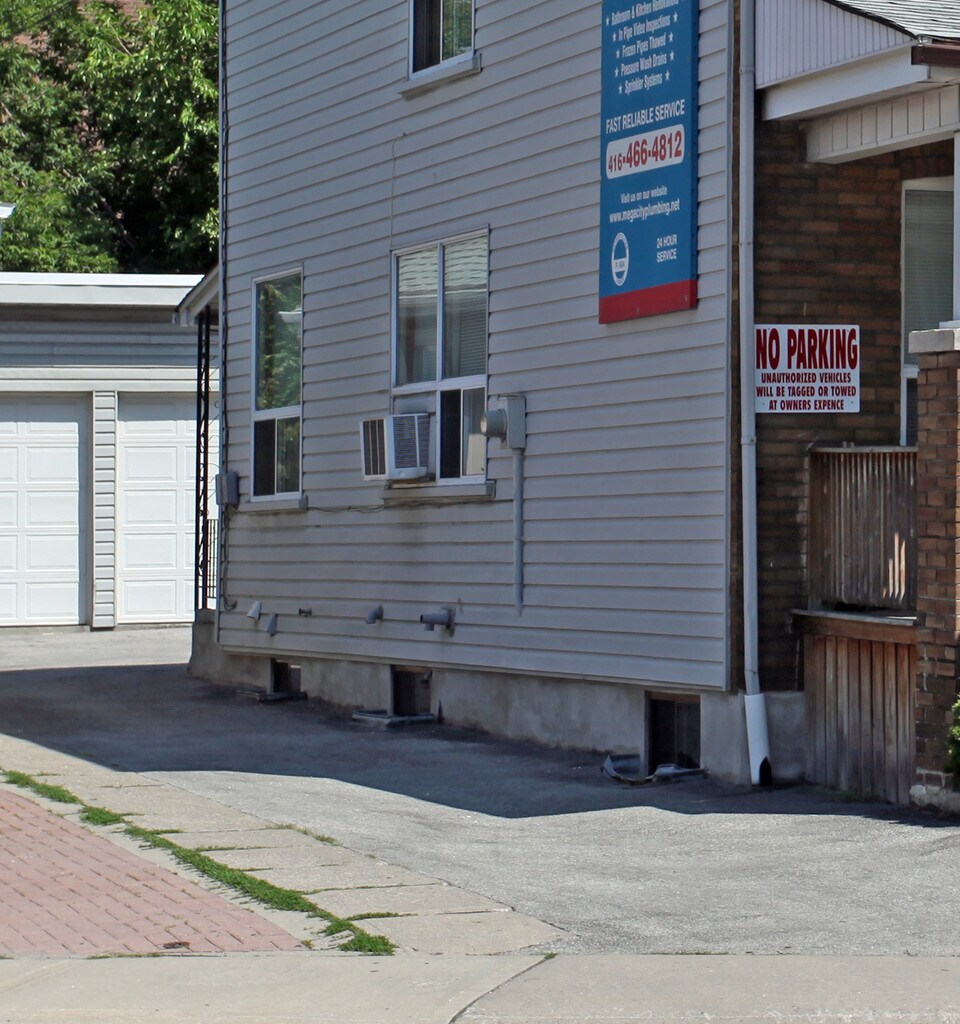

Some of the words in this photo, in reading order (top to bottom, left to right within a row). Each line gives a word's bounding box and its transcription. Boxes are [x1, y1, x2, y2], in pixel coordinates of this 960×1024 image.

[636, 2, 651, 17] Kitchen
[624, 26, 632, 41] Pipe
[633, 22, 645, 36] Video
[646, 15, 670, 33] Inspections
[622, 44, 636, 57] Frozen
[637, 40, 648, 55] Pipes
[649, 32, 666, 49] Thawed
[621, 62, 639, 76] Pressure
[640, 55, 652, 70] Wash
[653, 52, 667, 67] Drains
[625, 77, 643, 95] Sprinkler
[644, 73, 662, 90] Systems
[606, 115, 621, 134] FAST
[622, 108, 653, 130] RELIABLE
[655, 99, 685, 121] SERVICE
[608, 130, 682, 172] 416-466-4812
[621, 192, 630, 204] Visit
[631, 193, 635, 202] us
[636, 192, 642, 200] on
[651, 185, 667, 197] website
[609, 198, 680, 223] www.megacityplumbing.net
[657, 238, 662, 249] 24
[663, 234, 677, 247] HOUR
[657, 248, 677, 263] SERVICE
[756, 328, 780, 370] NO
[787, 328, 858, 370] PARKING
[761, 372, 817, 384] UNAUTHORIZED
[819, 372, 851, 384] VEHICLES
[756, 386, 773, 397] WILL
[776, 386, 785, 397] BE
[788, 386, 815, 397] TAGGED
[818, 386, 829, 397] OR
[831, 386, 856, 397] TOWED
[769, 400, 777, 411] AT
[780, 400, 811, 411] OWNERS
[814, 400, 844, 411] EXPENCE
